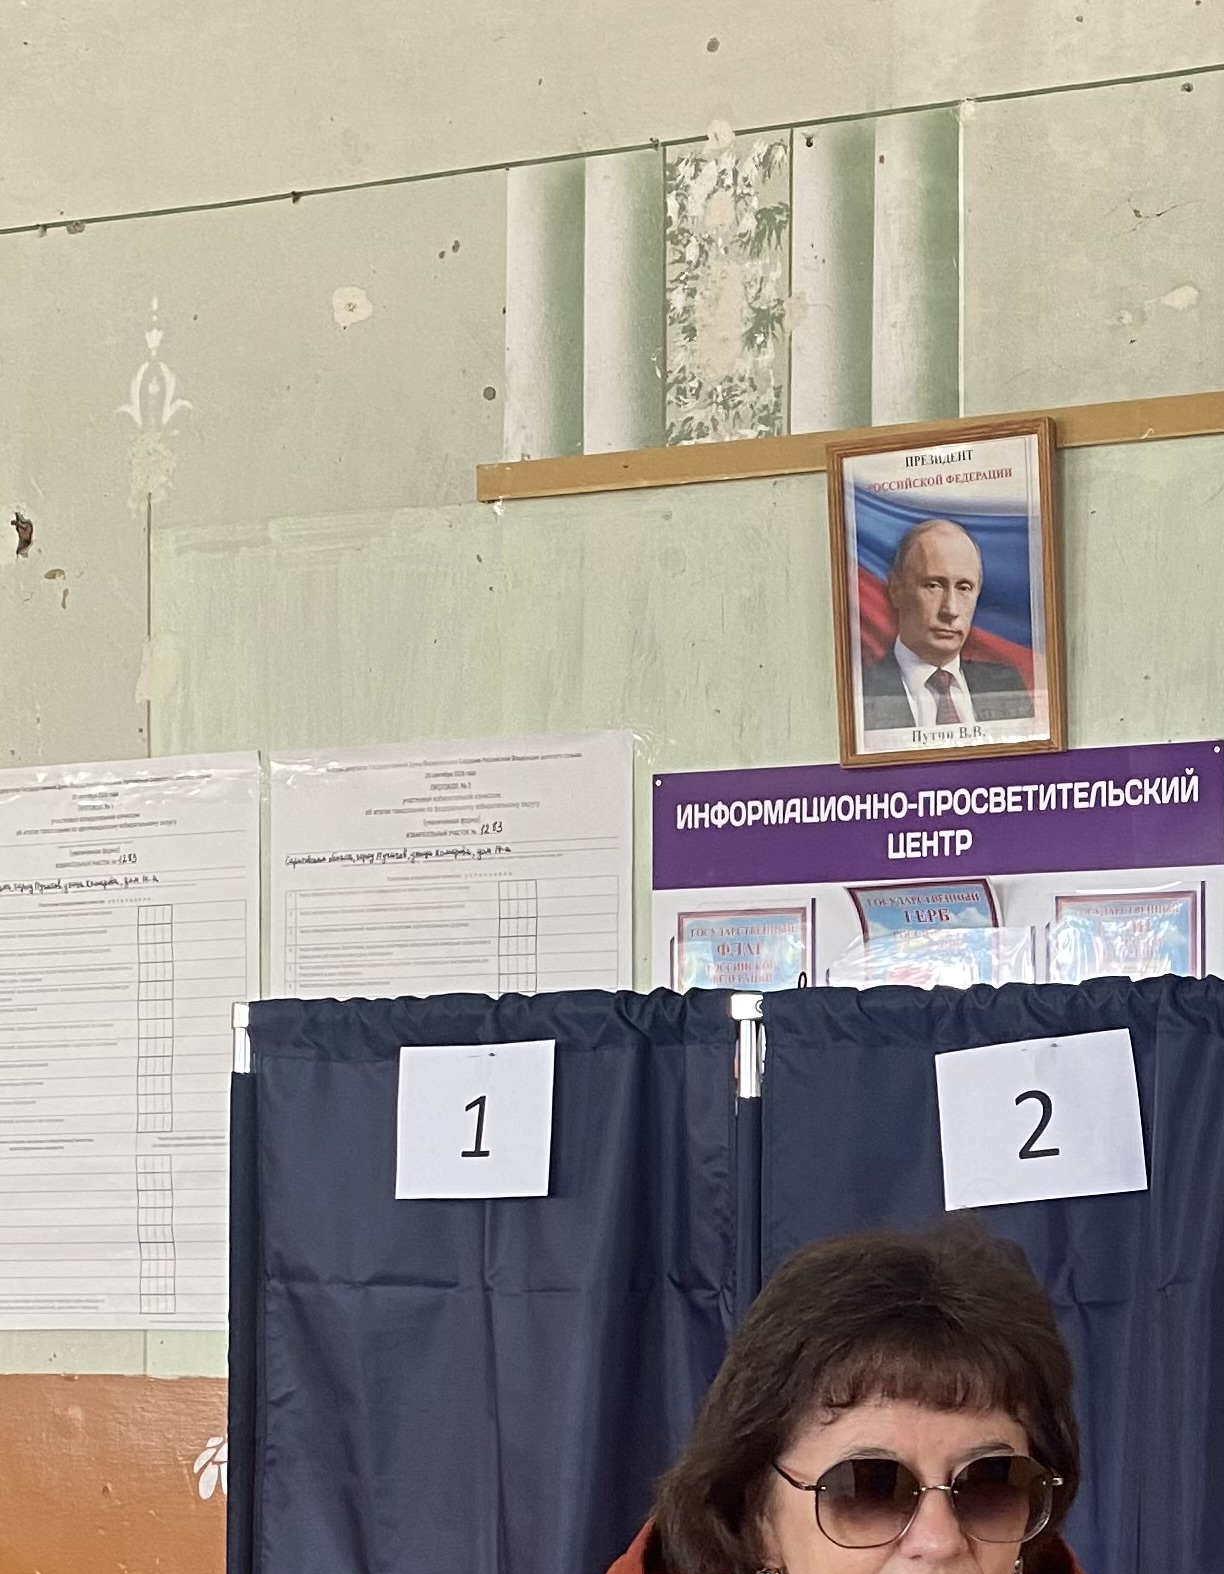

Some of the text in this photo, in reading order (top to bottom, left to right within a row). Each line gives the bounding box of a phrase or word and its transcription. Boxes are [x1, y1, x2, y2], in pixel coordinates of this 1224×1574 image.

[905, 449, 974, 468] ПРЕЗИДЕНТ
[945, 468, 1013, 484] ФЕДЕРАЦИИ
[912, 725, 986, 745] Путин В.В.
[676, 768, 1200, 830] ИНФОРМАЦИОННО-ПРОСВЕТИТЕЛЬСКИЙ
[887, 829, 973, 860] ЦЕНТР
[905, 908, 950, 923] ГЕРБ
[459, 1095, 491, 1158] 1
[1014, 1090, 1061, 1160] 2
